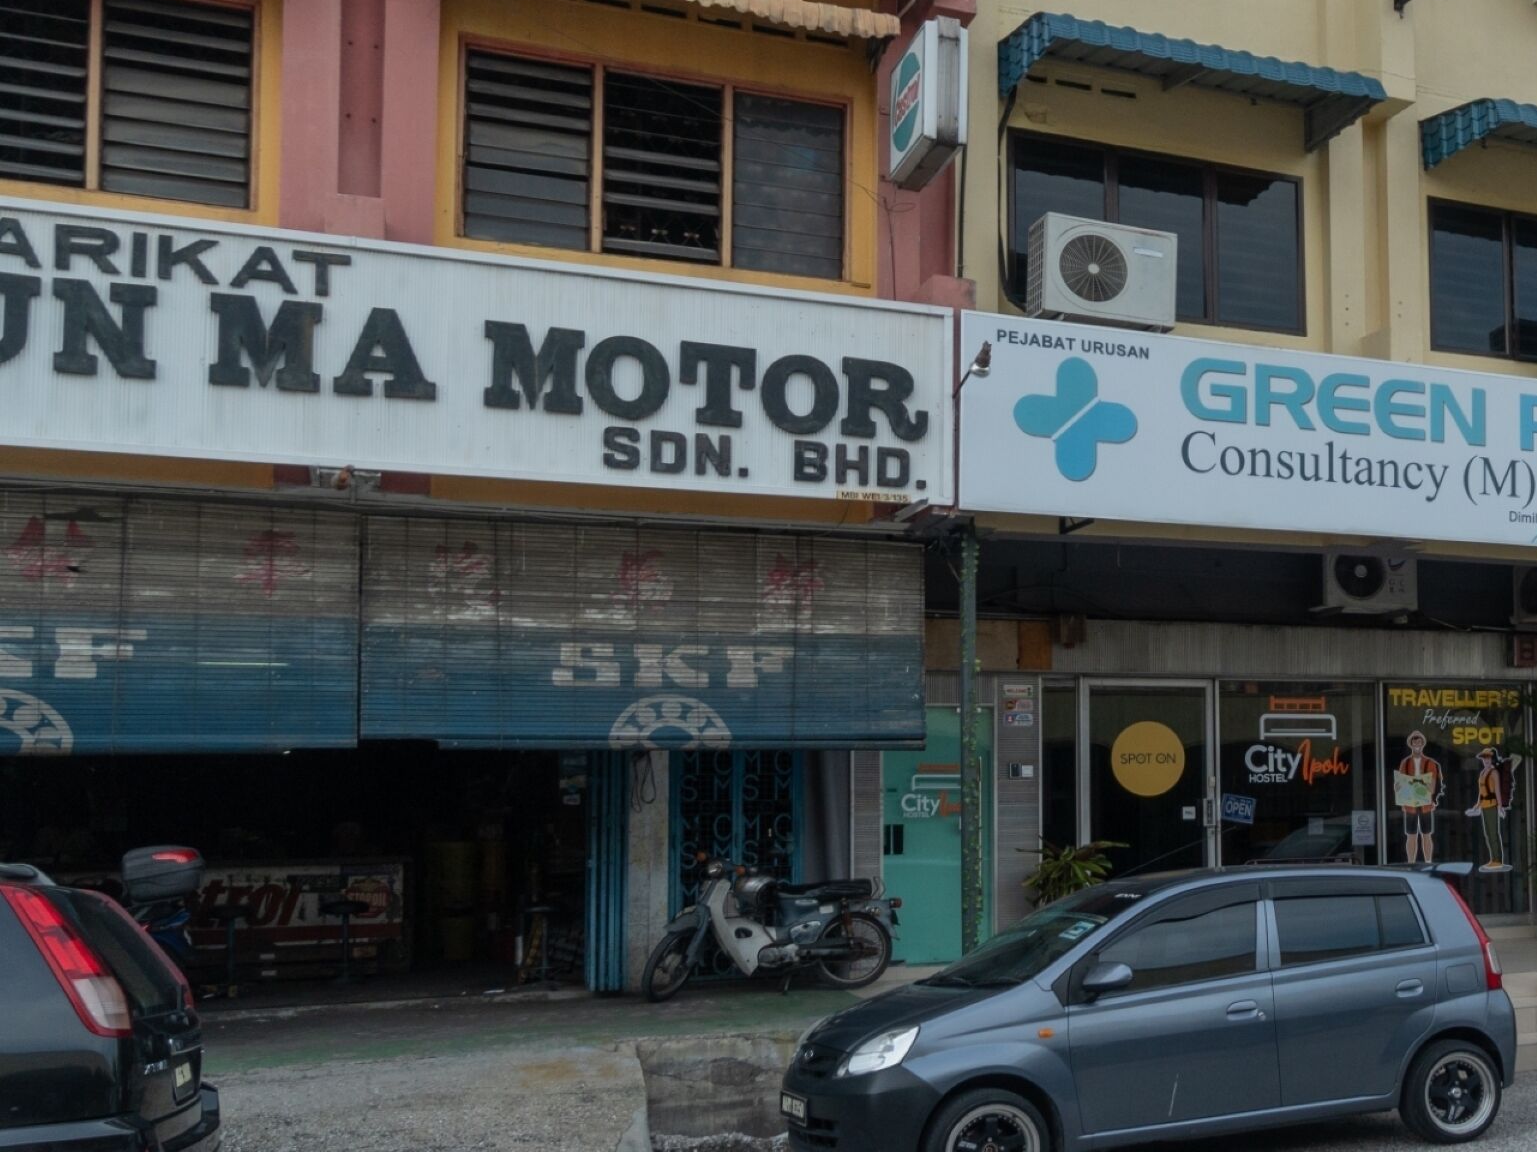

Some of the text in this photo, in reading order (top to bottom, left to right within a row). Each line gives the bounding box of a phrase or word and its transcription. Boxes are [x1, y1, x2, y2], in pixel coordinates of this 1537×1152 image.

[0, 219, 351, 297] ARIKAT
[996, 329, 1150, 360] PEJABAT URUSAN
[208, 291, 437, 402] MA
[482, 319, 929, 442] MOTOR
[1179, 357, 1487, 447] GREEN
[602, 424, 927, 490] SDN. BHD.
[1180, 430, 1450, 505] Consultancy
[1461, 454, 1537, 508] (M)
[552, 642, 796, 688] SKF
[1388, 688, 1520, 709] TRAVELLER'S
[1422, 708, 1480, 730] Preferred
[1452, 727, 1504, 745] SPOT
[1120, 751, 1178, 766] SPOT ON
[1245, 738, 1349, 785] City Ipoh
[1249, 773, 1288, 783] HOSTEL
[901, 793, 941, 817] City
[1224, 799, 1251, 817] OPEN
